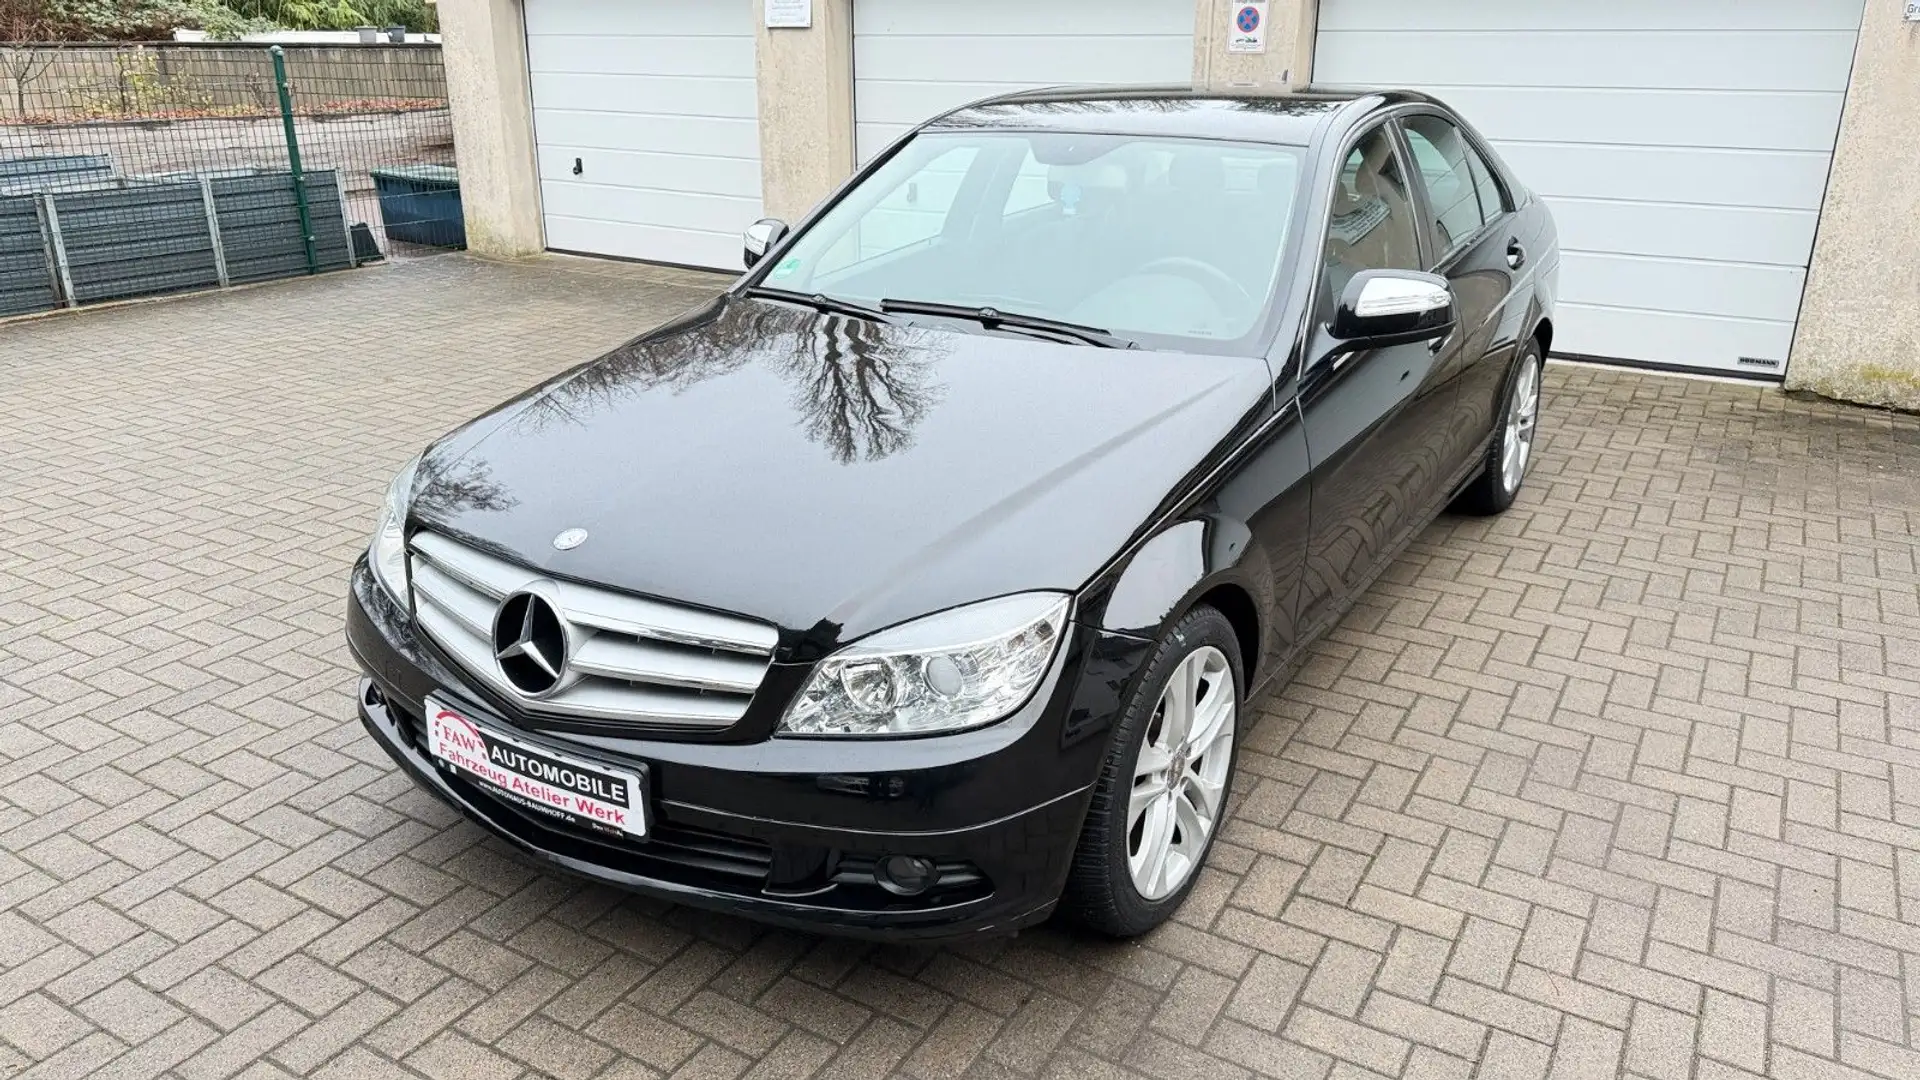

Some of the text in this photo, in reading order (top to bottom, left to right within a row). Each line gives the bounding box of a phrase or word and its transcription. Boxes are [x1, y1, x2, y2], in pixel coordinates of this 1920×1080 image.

[443, 724, 476, 752] FAW
[439, 742, 625, 825] Fahrzeug Atelier Werk
[491, 745, 625, 803] AUTOMOBILE
